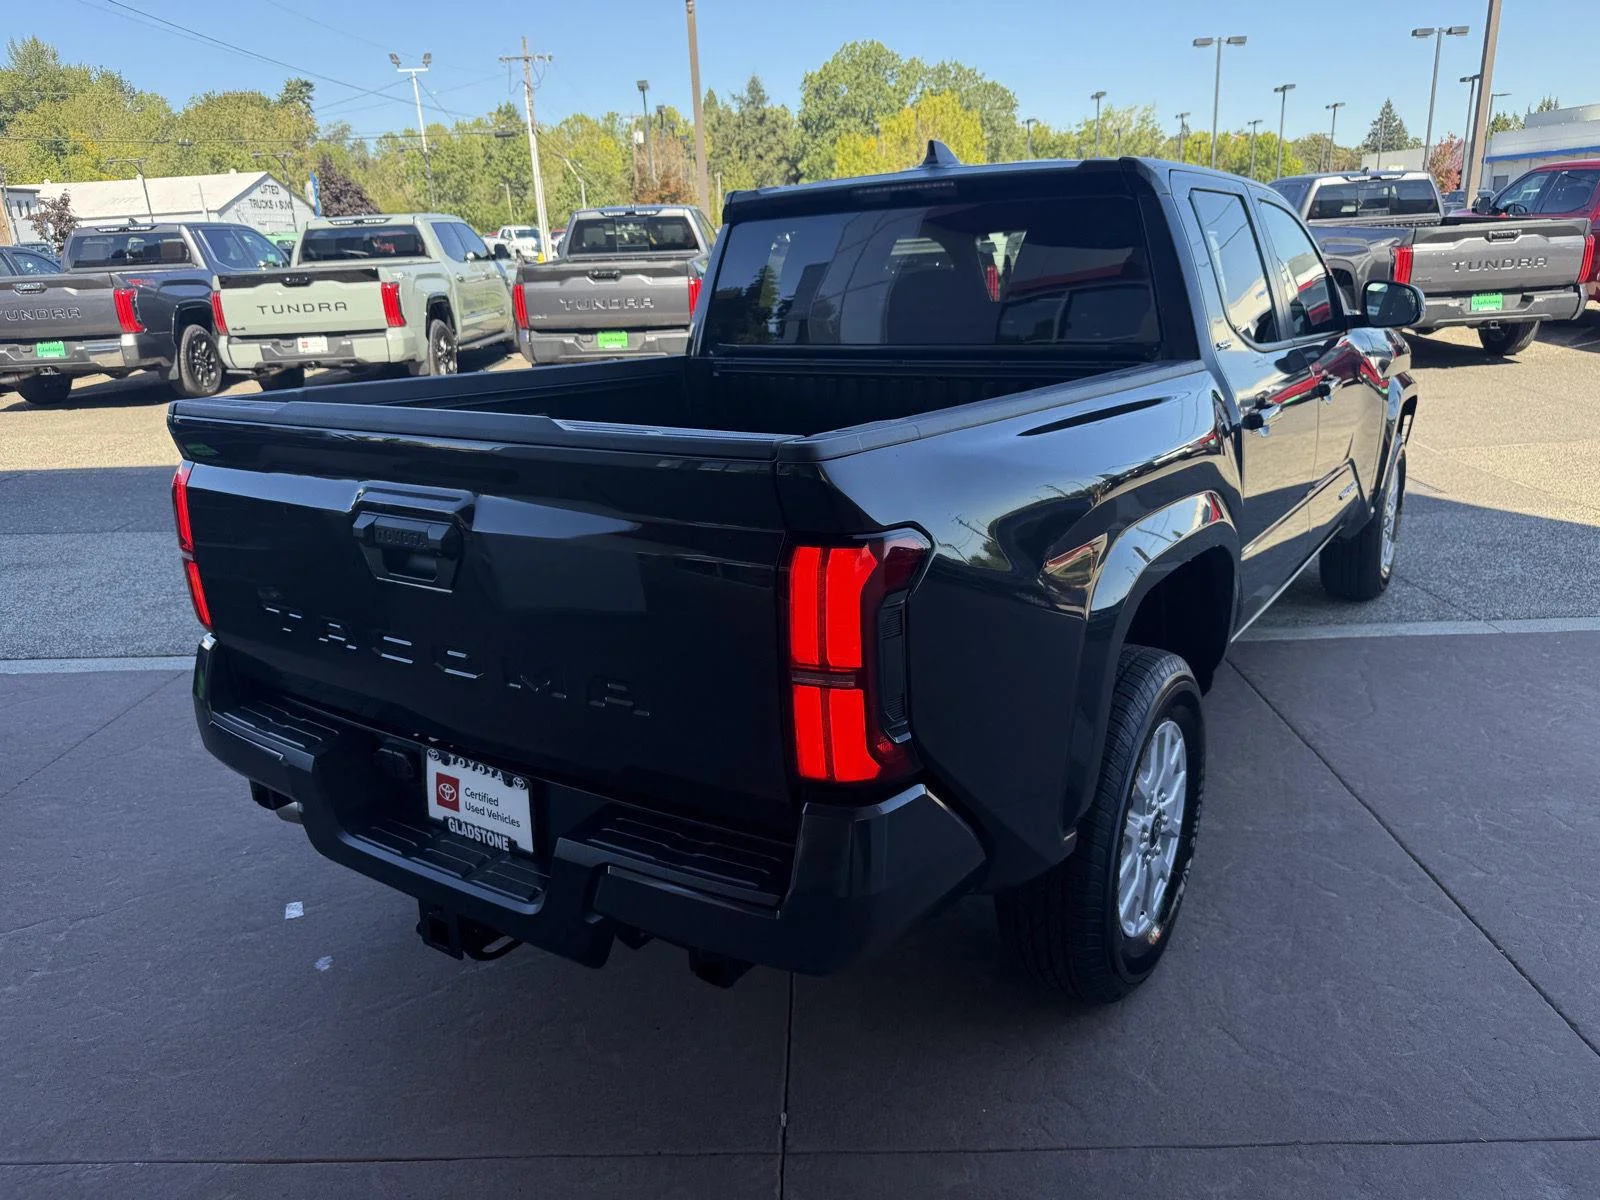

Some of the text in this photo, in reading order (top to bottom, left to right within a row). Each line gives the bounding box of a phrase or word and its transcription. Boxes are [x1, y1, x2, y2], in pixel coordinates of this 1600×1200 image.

[260, 184, 280, 195] LIFTED
[1452, 257, 1548, 273] TUNDRA
[257, 301, 348, 315] TUNDRA
[560, 297, 655, 311] TUNDRA
[261, 599, 651, 717] TACOMA
[448, 753, 504, 781] TOYOTA
[464, 787, 499, 807] Certified
[464, 801, 521, 828] Used Vehicles
[448, 817, 510, 852] GLADSTONE
